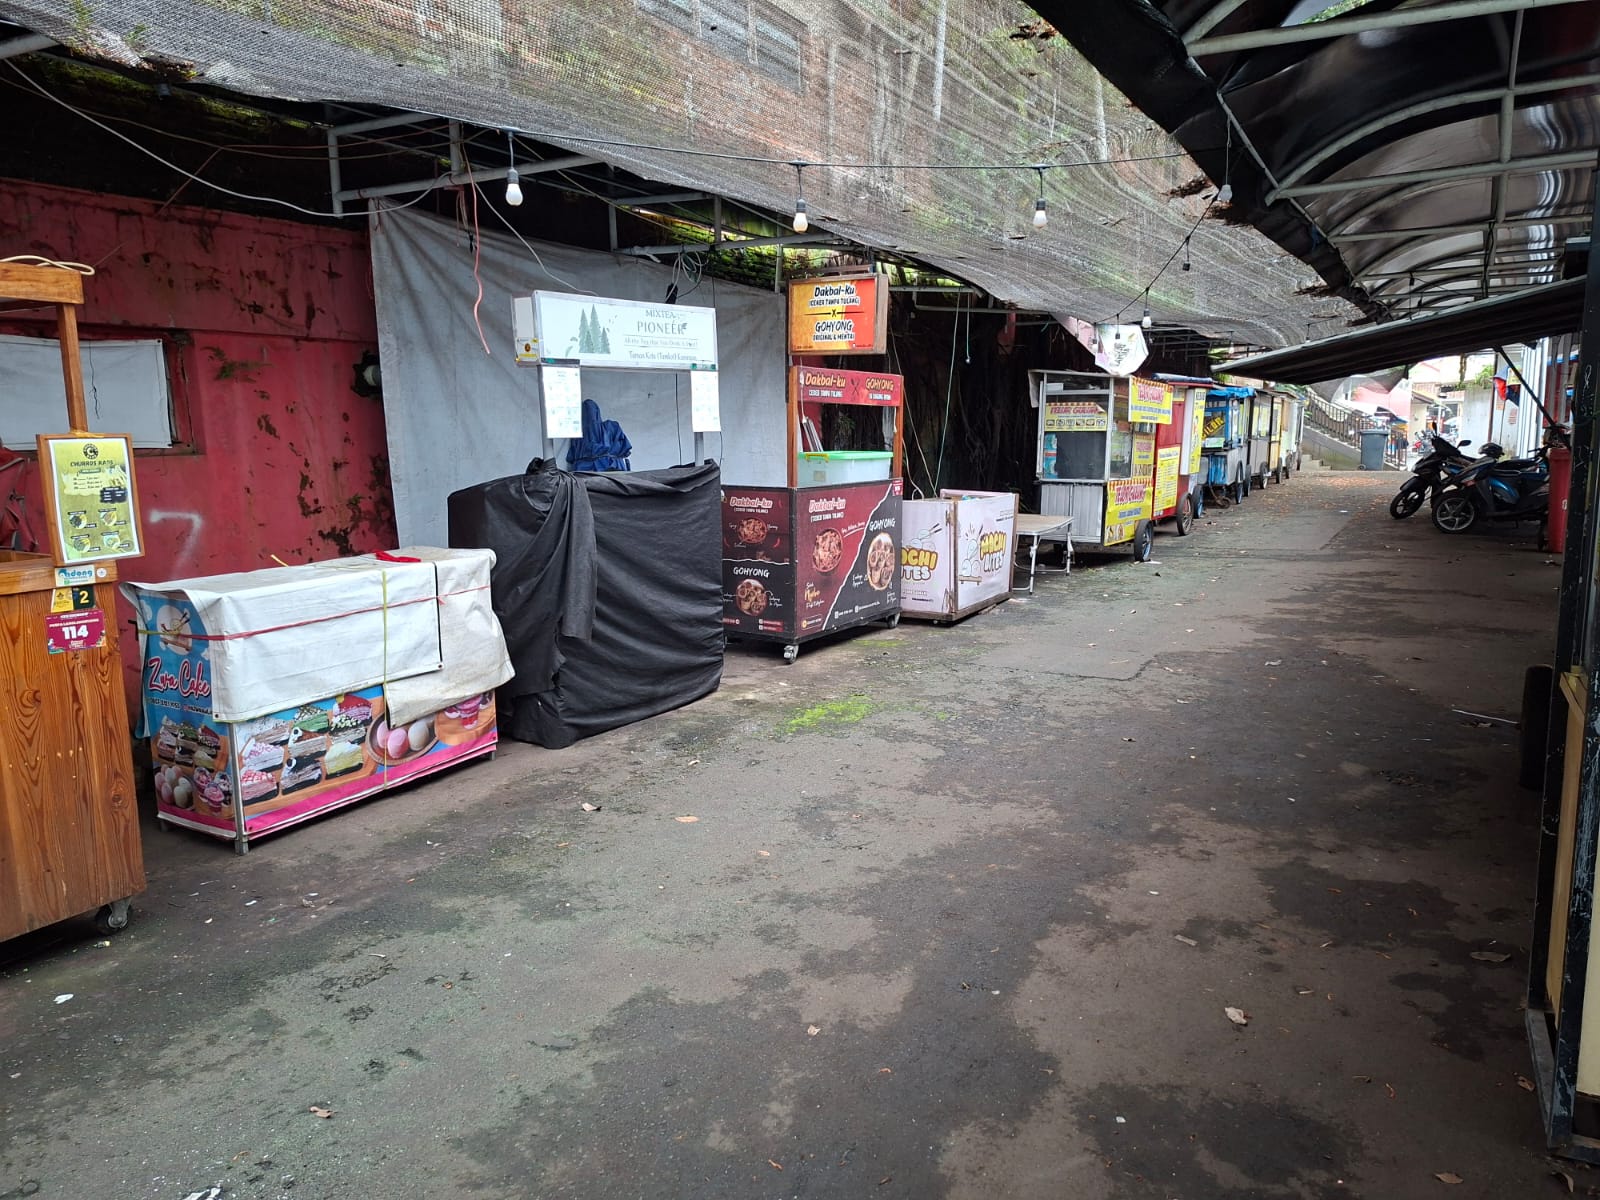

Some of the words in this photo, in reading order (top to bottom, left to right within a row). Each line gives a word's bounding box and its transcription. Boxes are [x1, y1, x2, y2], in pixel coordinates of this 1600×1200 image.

[815, 321, 852, 332] GOHYONG
[901, 547, 938, 570] OCHI
[733, 567, 769, 578] GOHYONG
[79, 590, 90, 604] 2
[62, 624, 89, 640] 114
